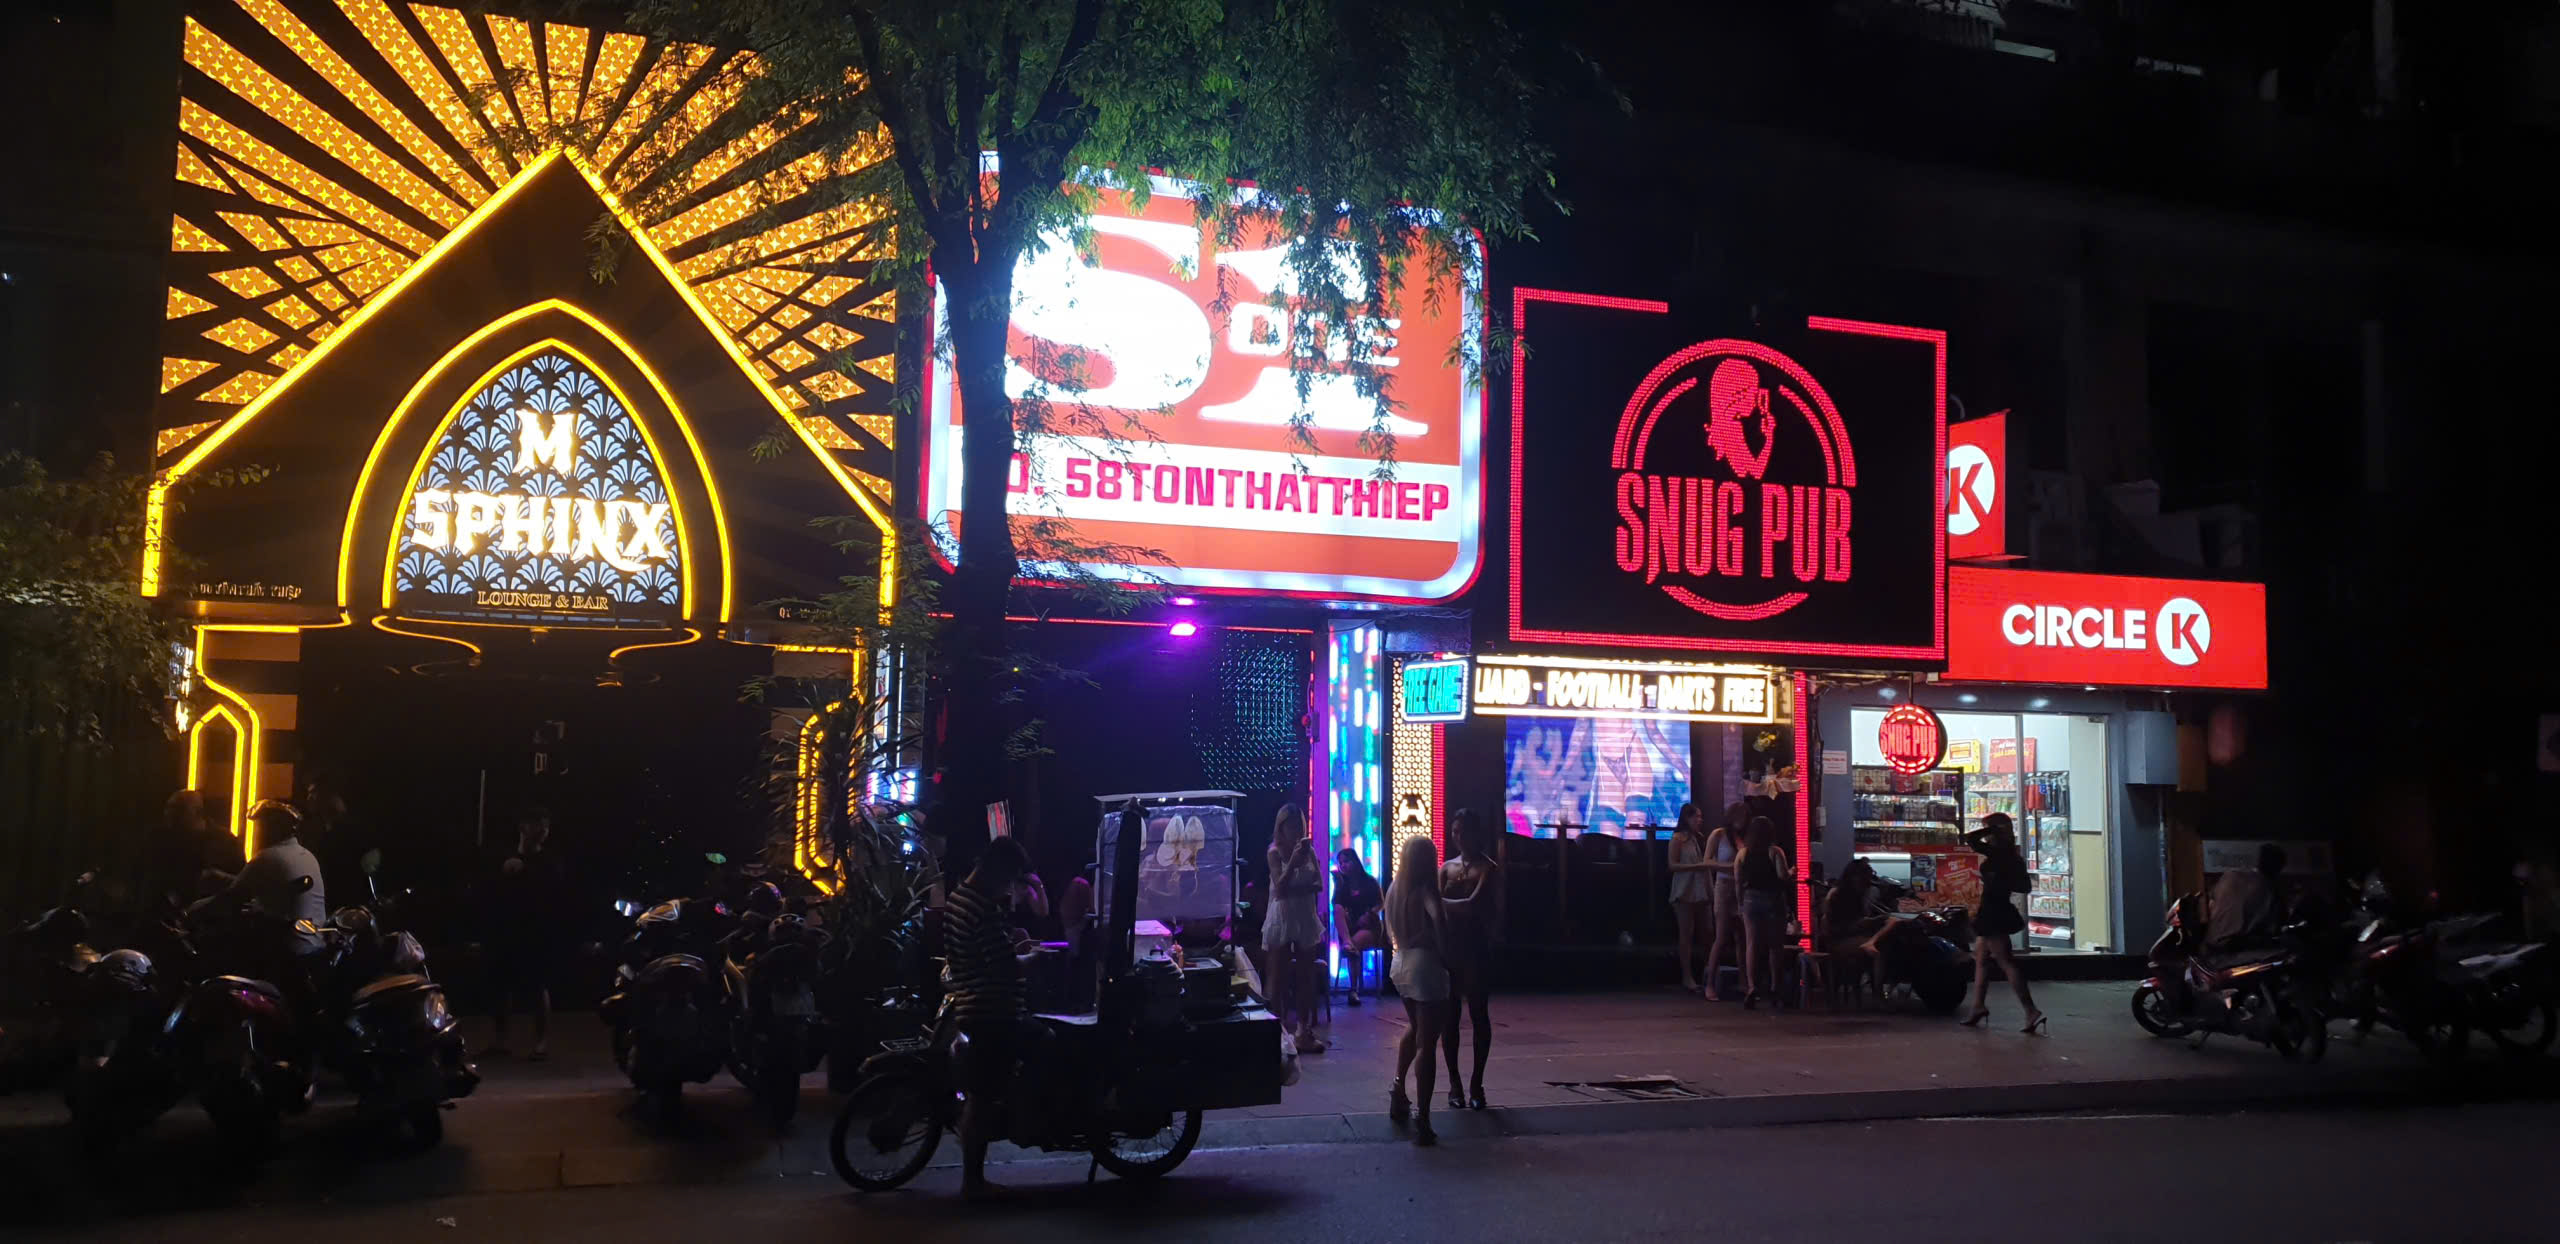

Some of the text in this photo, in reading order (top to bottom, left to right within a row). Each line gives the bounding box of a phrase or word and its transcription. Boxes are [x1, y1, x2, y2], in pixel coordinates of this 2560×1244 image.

[511, 408, 577, 474] M
[1066, 457, 1449, 521] 58TONTHATTHIEP
[1947, 461, 1988, 530] K
[410, 487, 671, 573] SPHINX
[1616, 472, 1852, 584] SNUG PUB
[477, 590, 609, 610] LOUNGE & BAR
[2002, 603, 2208, 662] CIRCLE K
[1474, 667, 1530, 706] LIARD
[1547, 670, 1642, 709] FOOTBALL
[1659, 675, 1716, 712] DARTS
[1723, 677, 1766, 713] FREE
[1880, 723, 1912, 758] SNUG
[1912, 724, 1937, 758] PUB
